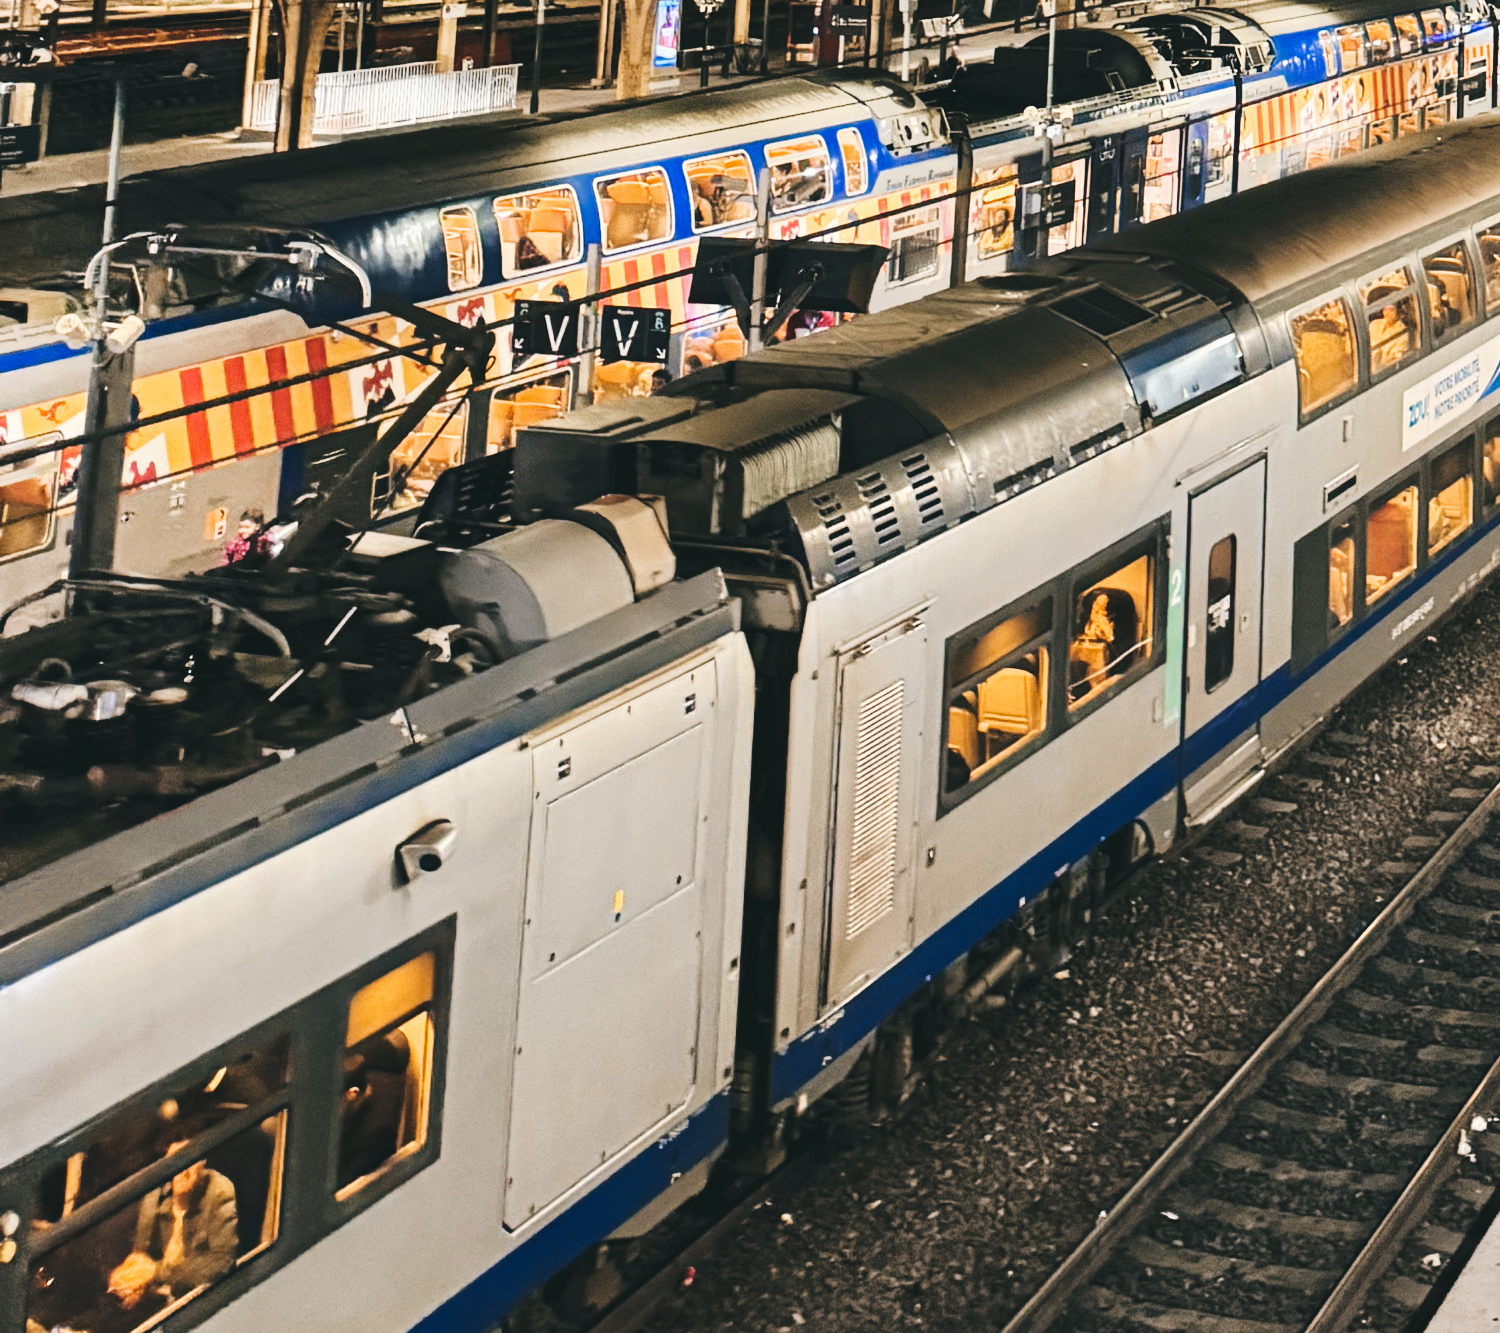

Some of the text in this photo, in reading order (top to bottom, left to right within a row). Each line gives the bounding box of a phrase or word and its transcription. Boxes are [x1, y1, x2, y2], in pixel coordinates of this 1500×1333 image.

[544, 314, 570, 352] V
[612, 318, 639, 356] V
[1170, 568, 1182, 607] 2
